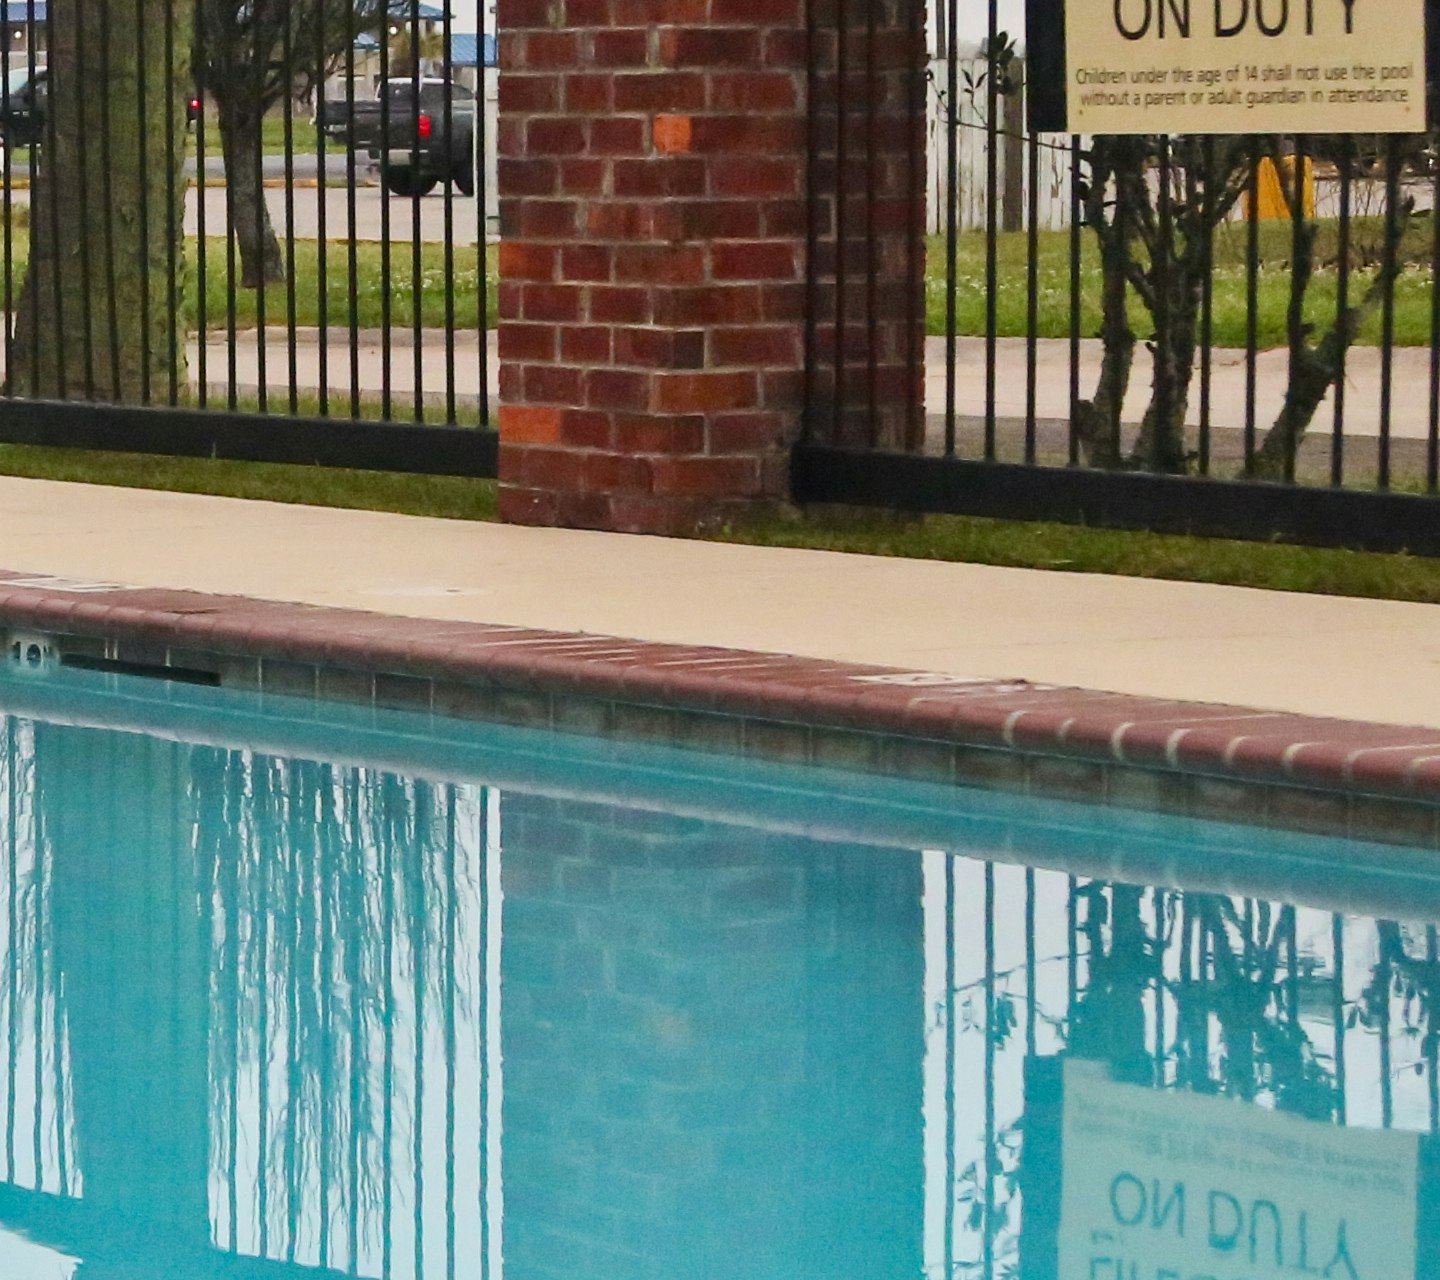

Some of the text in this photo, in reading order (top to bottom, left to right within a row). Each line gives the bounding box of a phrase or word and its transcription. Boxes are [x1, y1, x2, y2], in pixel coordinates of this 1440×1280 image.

[1076, 68, 1126, 85] Children
[1131, 67, 1167, 84] under
[1173, 66, 1193, 83] the
[1197, 69, 1221, 87] age
[1226, 64, 1239, 82] of
[1261, 64, 1292, 82] shall
[1296, 66, 1320, 81] not
[1324, 67, 1348, 80] use
[1352, 63, 1376, 80] the
[1380, 62, 1413, 83] pool
[1080, 86, 1409, 109] without a parent or adult guardian in attendance
